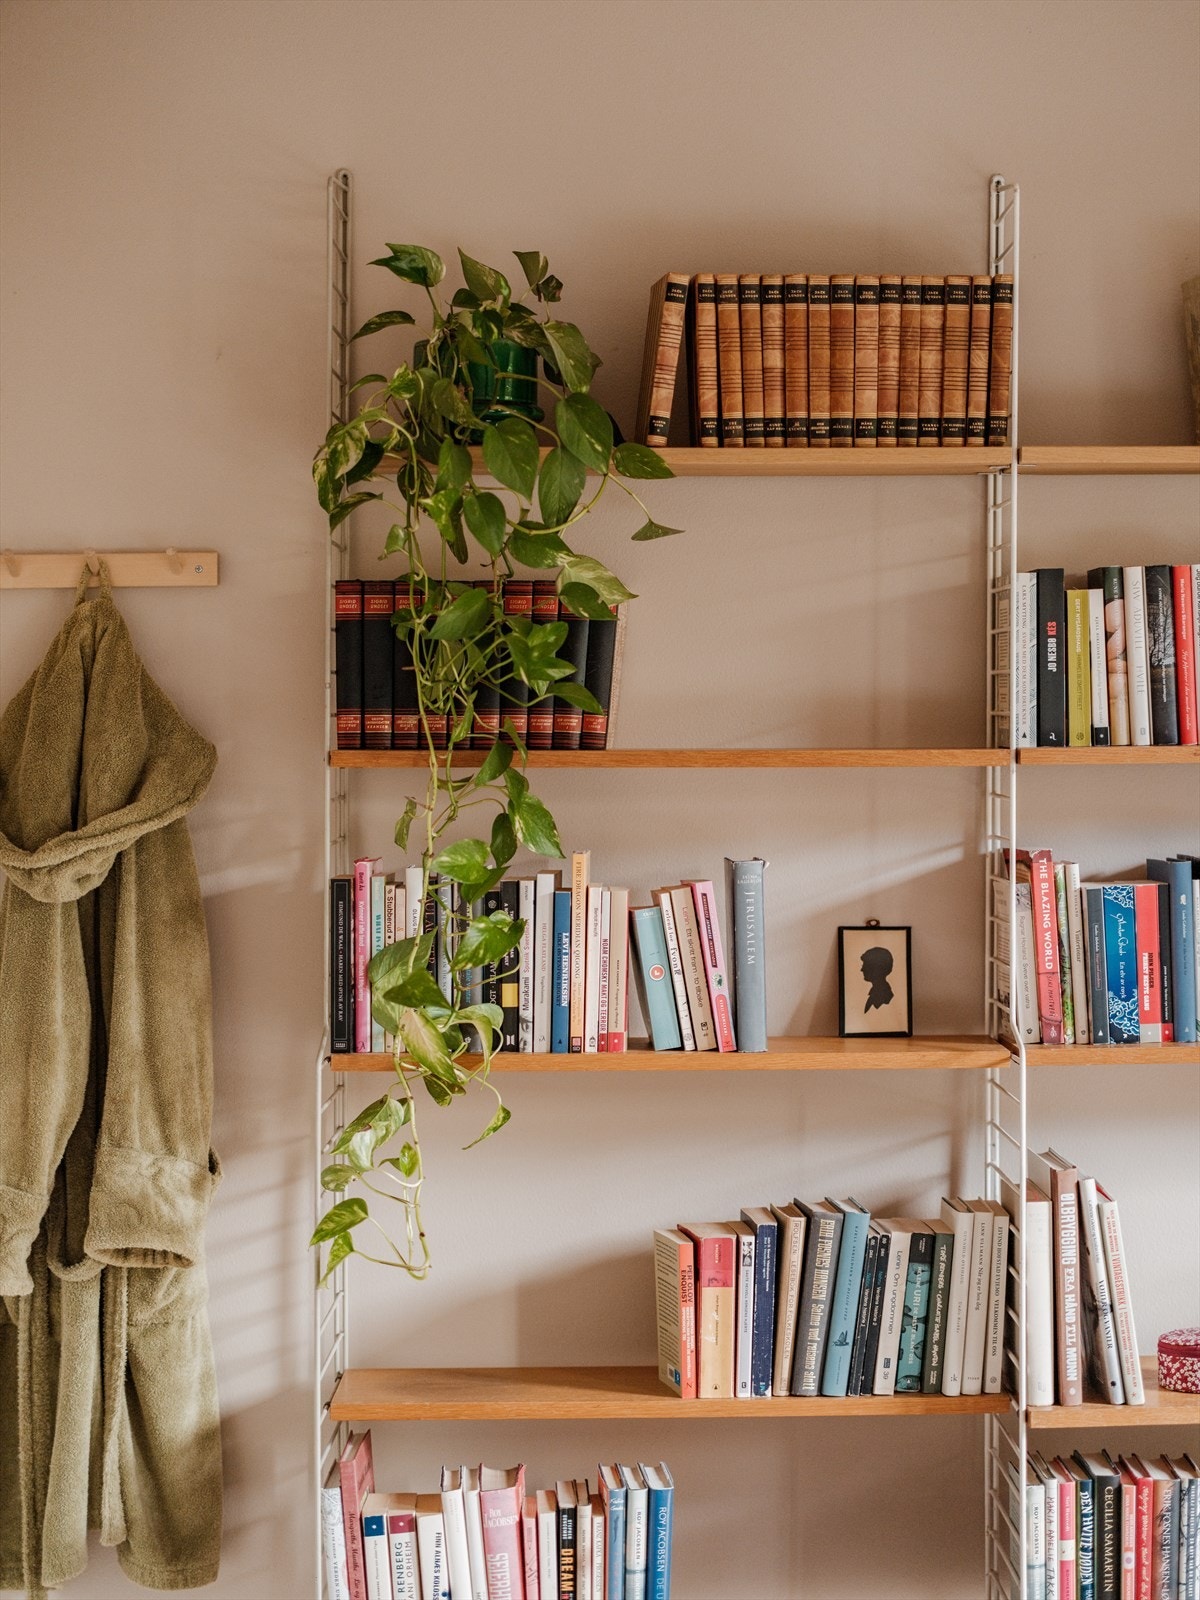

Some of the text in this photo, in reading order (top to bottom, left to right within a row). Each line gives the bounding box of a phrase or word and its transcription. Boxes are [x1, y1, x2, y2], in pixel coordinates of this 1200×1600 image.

[1132, 580, 1140, 600] SIW
[1047, 663, 1057, 672] JO
[744, 891, 756, 965] JERUSALEM
[1039, 858, 1053, 970] THE BLAZING WORLD
[1120, 961, 1126, 970] En
[601, 999, 608, 1008] OG
[816, 1239, 831, 1268] FOSNES
[789, 1260, 797, 1292] LESEBOK
[812, 1269, 828, 1301] HANSEN
[892, 1273, 901, 1287] Om
[1060, 1193, 1078, 1381] ØLBRYGGING FRA HÅND TIL MUNN
[887, 1289, 898, 1334] ungdommen
[913, 1290, 921, 1306] URI
[809, 1304, 825, 1326] Salme
[784, 1310, 794, 1359] FOLKESKOLEN
[808, 1328, 822, 1340] ved
[805, 1342, 820, 1370] reisens
[802, 1372, 817, 1391] slutt
[882, 1371, 890, 1380] 39
[656, 1507, 667, 1572] ROY JACOBSEN
[1046, 1529, 1054, 1562] AMELIE
[1079, 1491, 1094, 1585] DEN HVITE DØDEN
[1104, 1486, 1114, 1592] CECILIA SAMARTIN
[1161, 1489, 1171, 1582] ERIK FOSNES HANSEN
[394, 1542, 405, 1593] RENBERG
[404, 1540, 413, 1578] ORHEIM
[433, 1550, 441, 1574] ALNÆS
[561, 1548, 574, 1591] DREAM
[1047, 1568, 1055, 1596] TAKK
